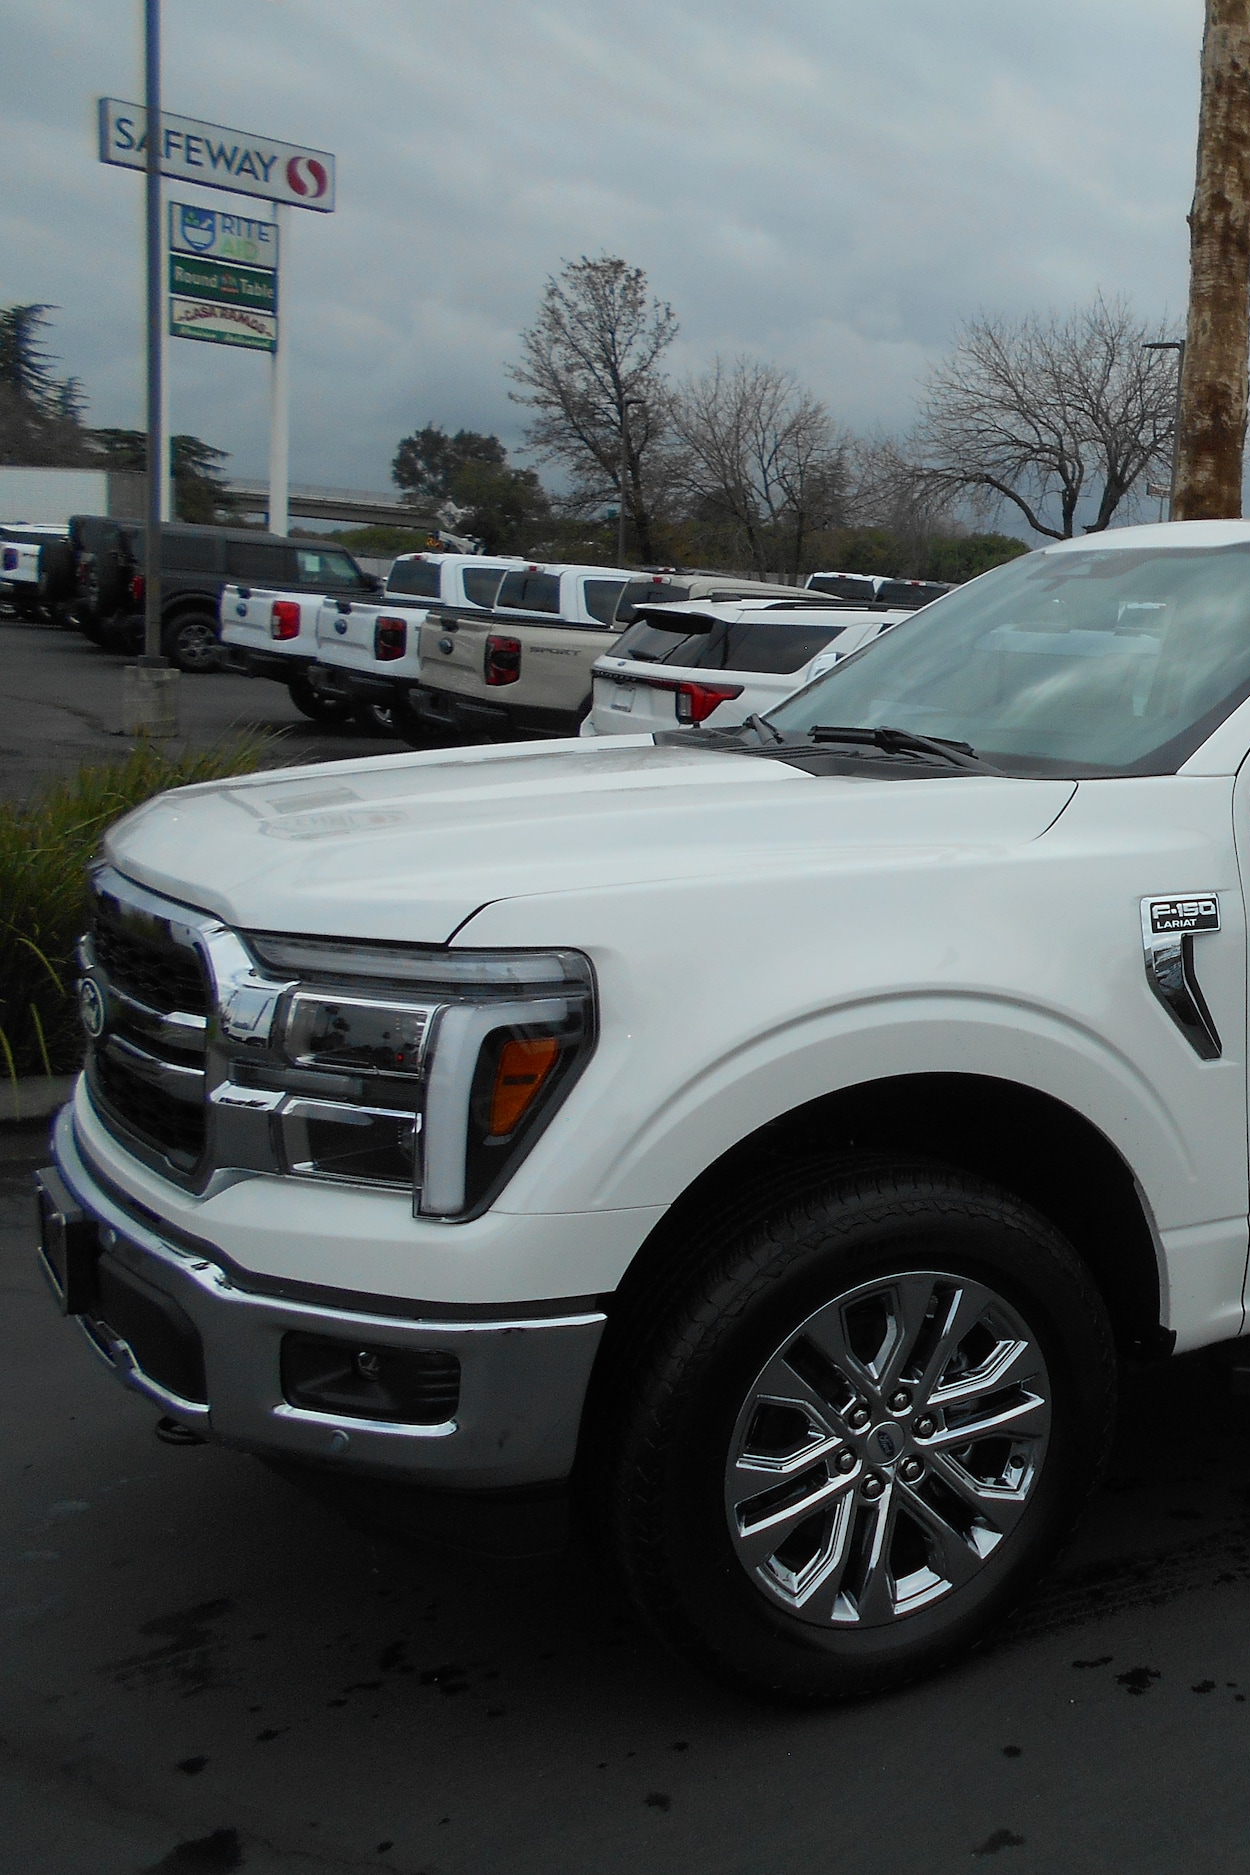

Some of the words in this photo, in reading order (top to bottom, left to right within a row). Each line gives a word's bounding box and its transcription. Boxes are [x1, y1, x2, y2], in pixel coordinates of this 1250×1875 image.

[221, 213, 270, 243] RITE
[174, 265, 218, 289] Round
[239, 277, 274, 299] Table
[530, 646, 582, 656] SPORT
[1151, 900, 1216, 919] F-150
[1156, 918, 1197, 929] LARIAT
